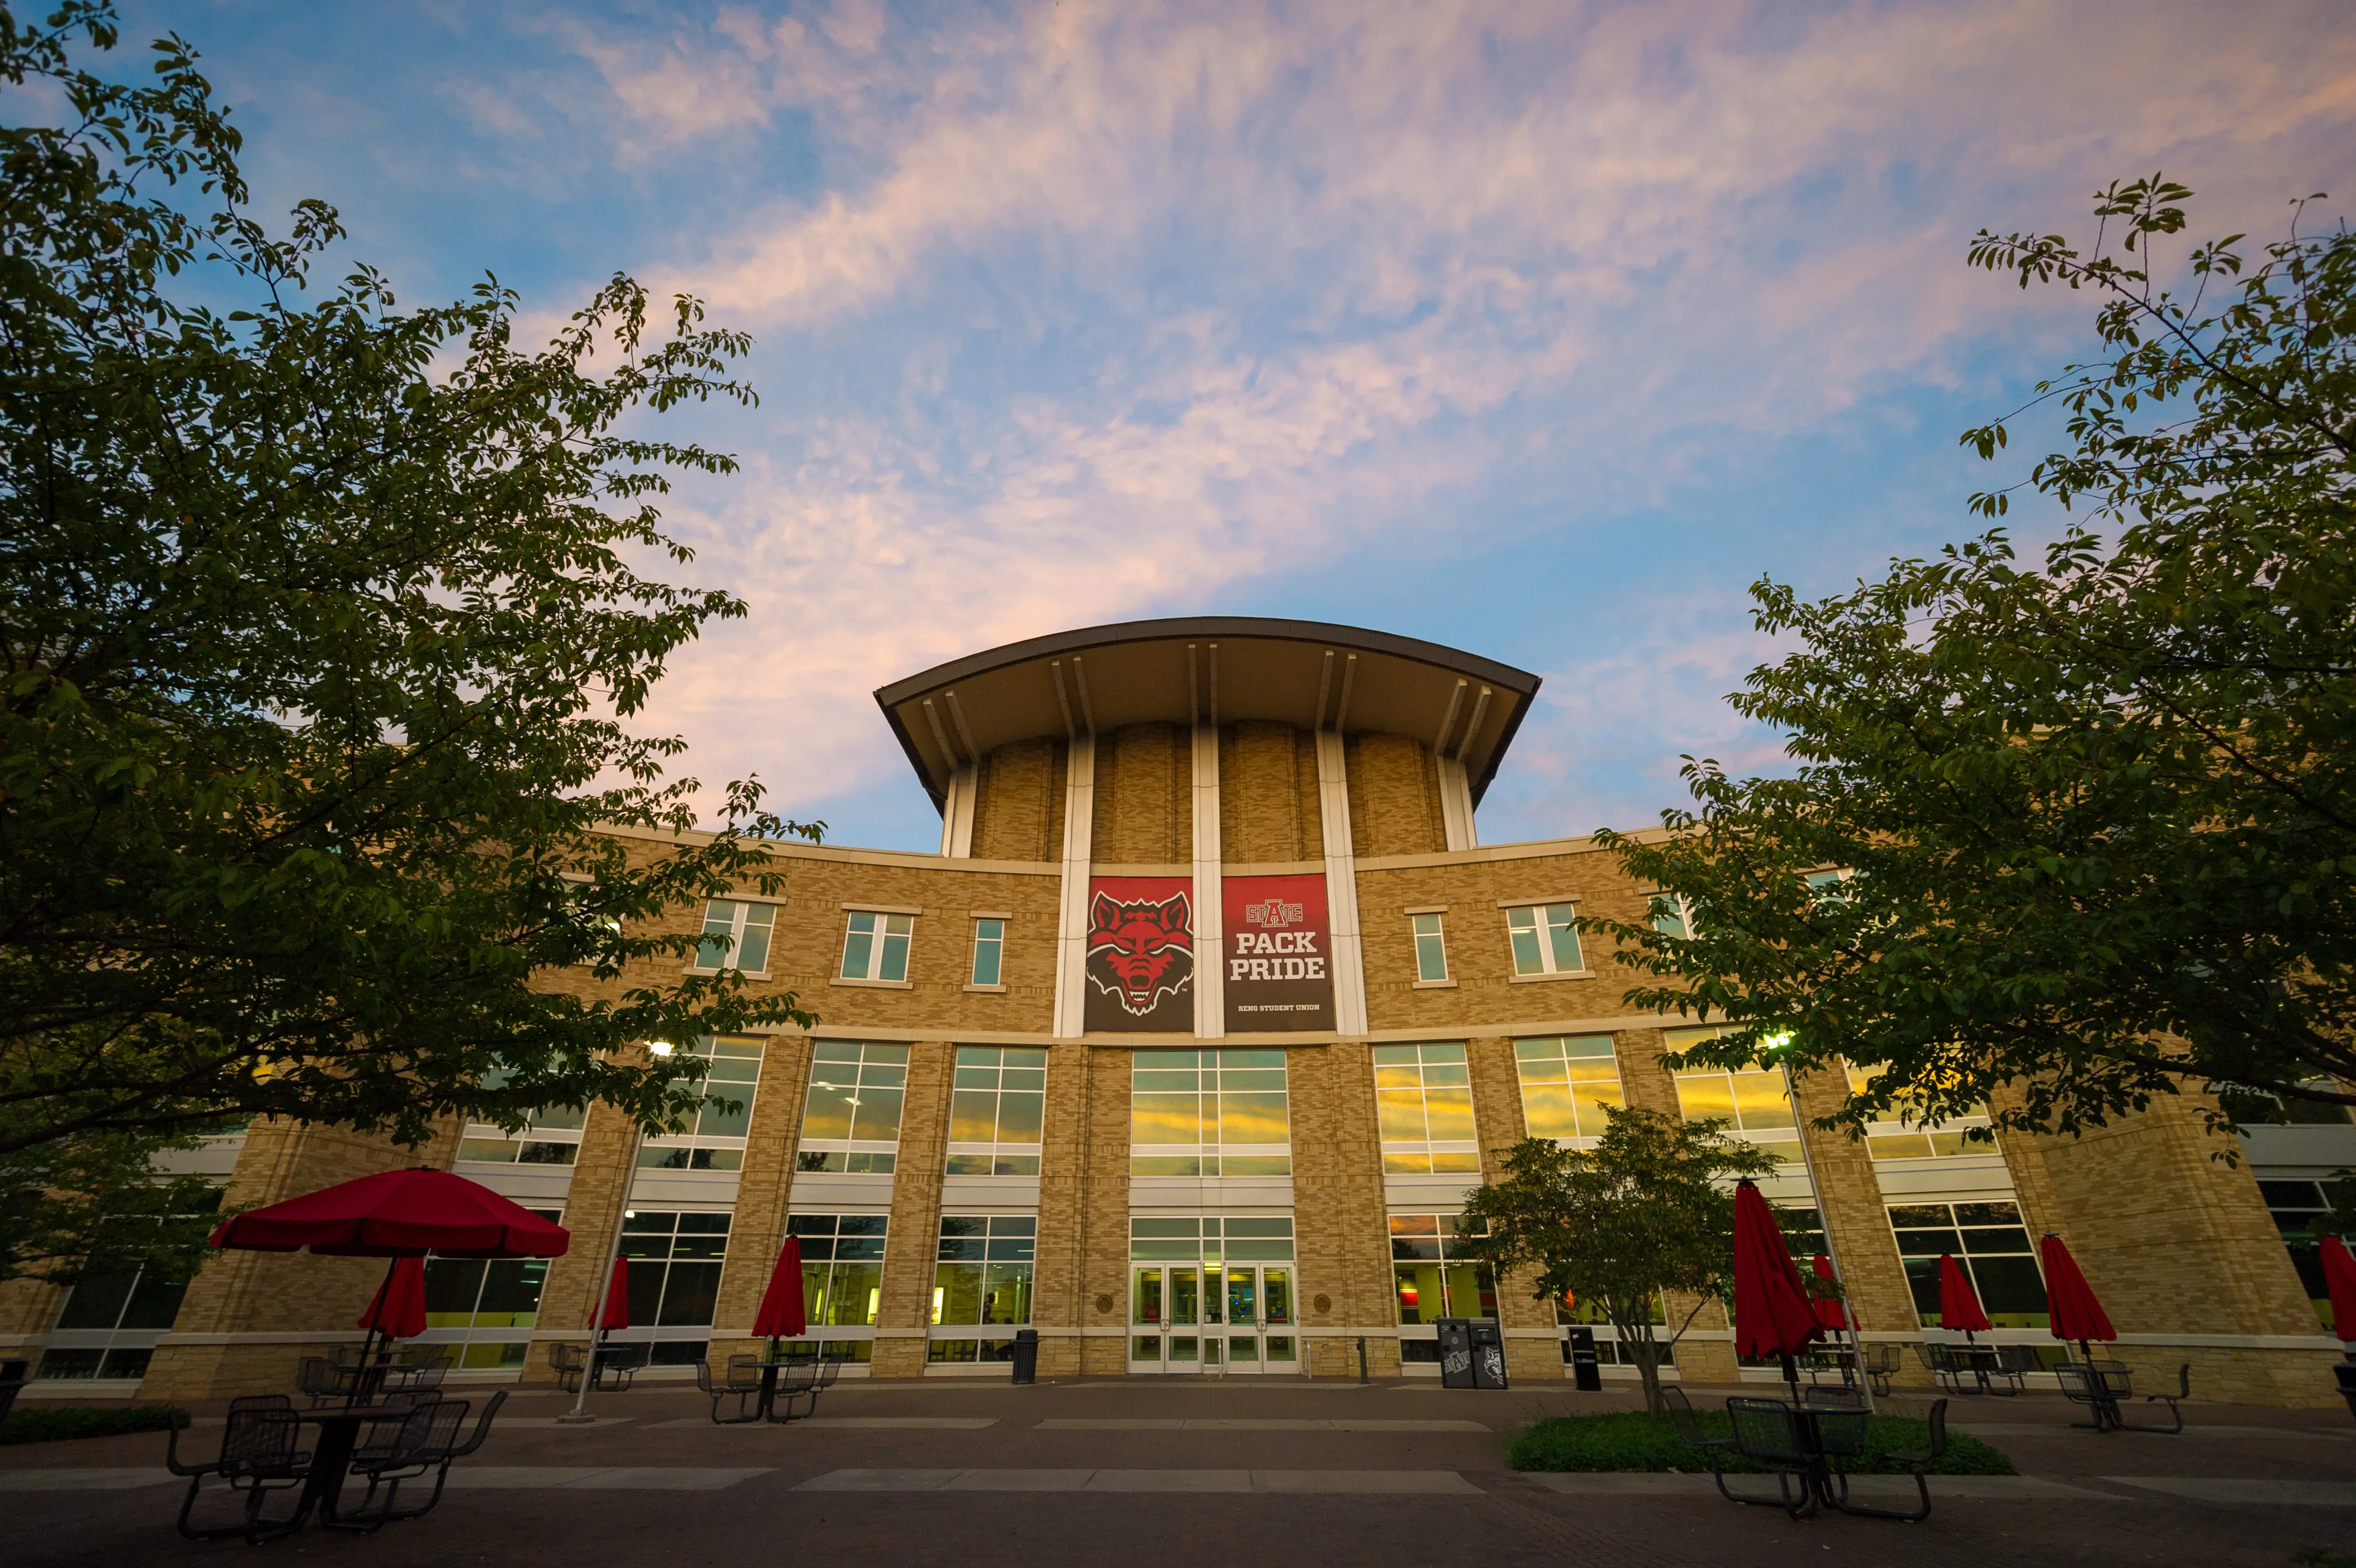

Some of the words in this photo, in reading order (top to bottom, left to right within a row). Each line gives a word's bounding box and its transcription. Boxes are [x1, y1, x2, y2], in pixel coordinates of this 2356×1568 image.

[1246, 899, 1303, 928] STATE
[1236, 932, 1317, 954] PACK
[1230, 958, 1325, 980] PRIDE
